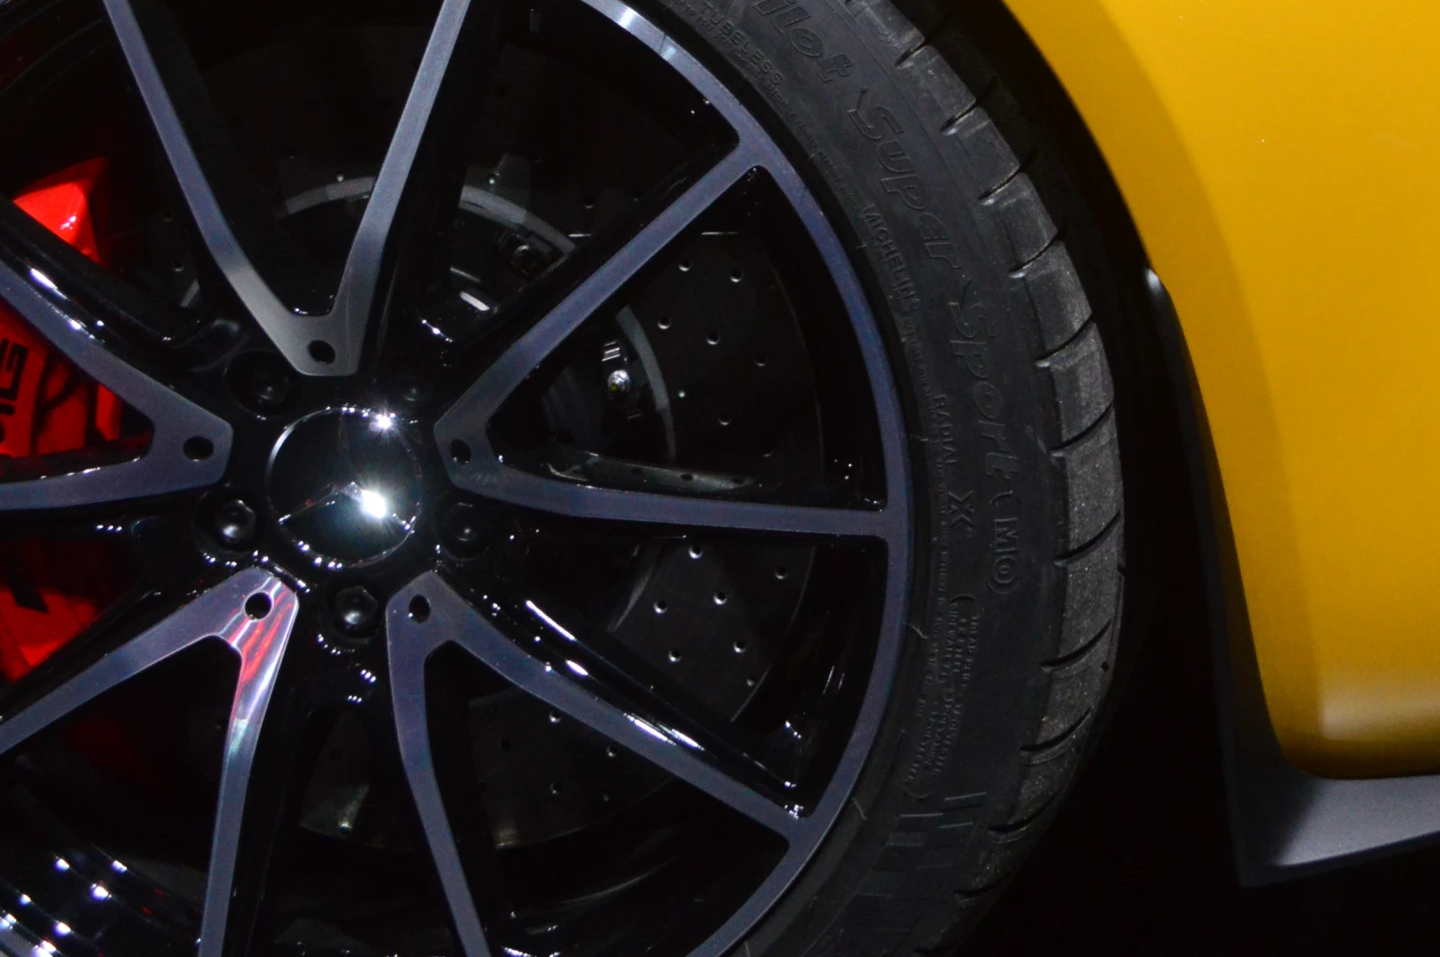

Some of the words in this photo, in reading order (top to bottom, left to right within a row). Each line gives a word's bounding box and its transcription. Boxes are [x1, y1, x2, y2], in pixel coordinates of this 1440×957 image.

[701, 0, 783, 86] TUBELESS
[846, 101, 965, 272] Super
[945, 297, 1020, 479] Sport
[863, 201, 916, 300] MICHELIN
[933, 394, 957, 466] RADIAL
